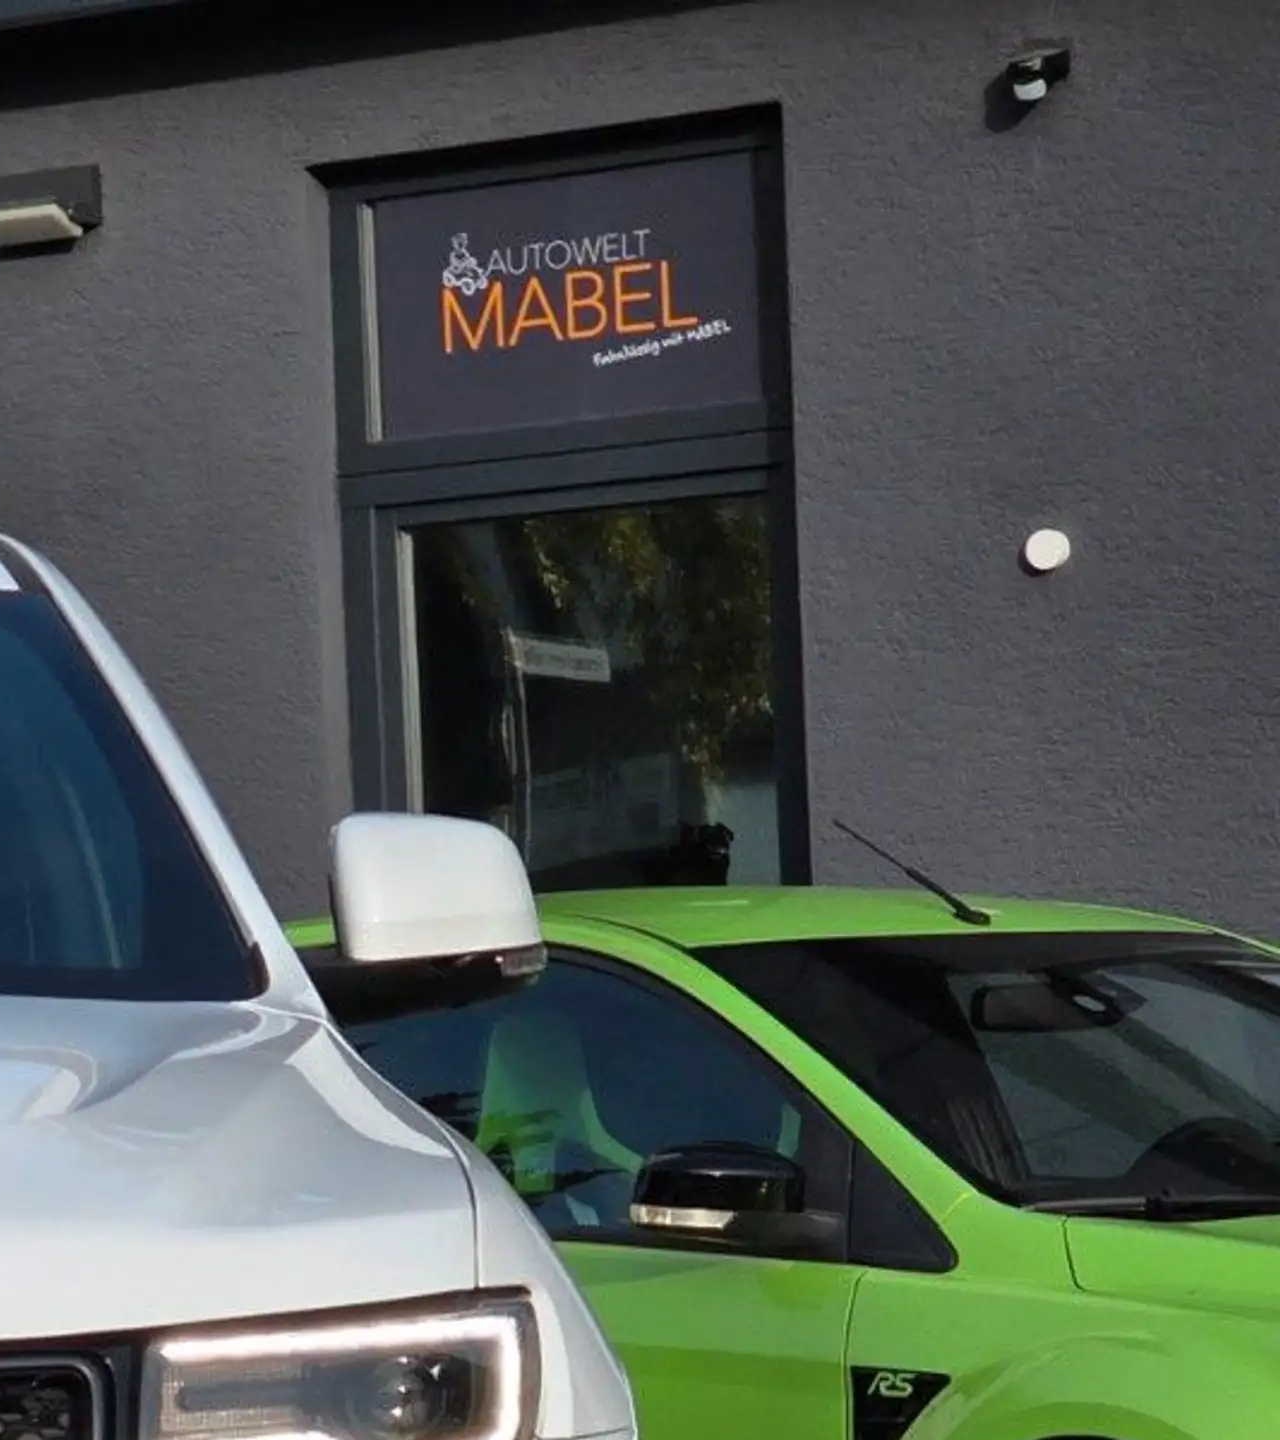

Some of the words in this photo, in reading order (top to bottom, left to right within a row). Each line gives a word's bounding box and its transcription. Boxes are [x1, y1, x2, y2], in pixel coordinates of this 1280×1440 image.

[485, 229, 651, 276] AUTOWELT
[443, 259, 698, 354] MABEL
[867, 1370, 917, 1398] RS
